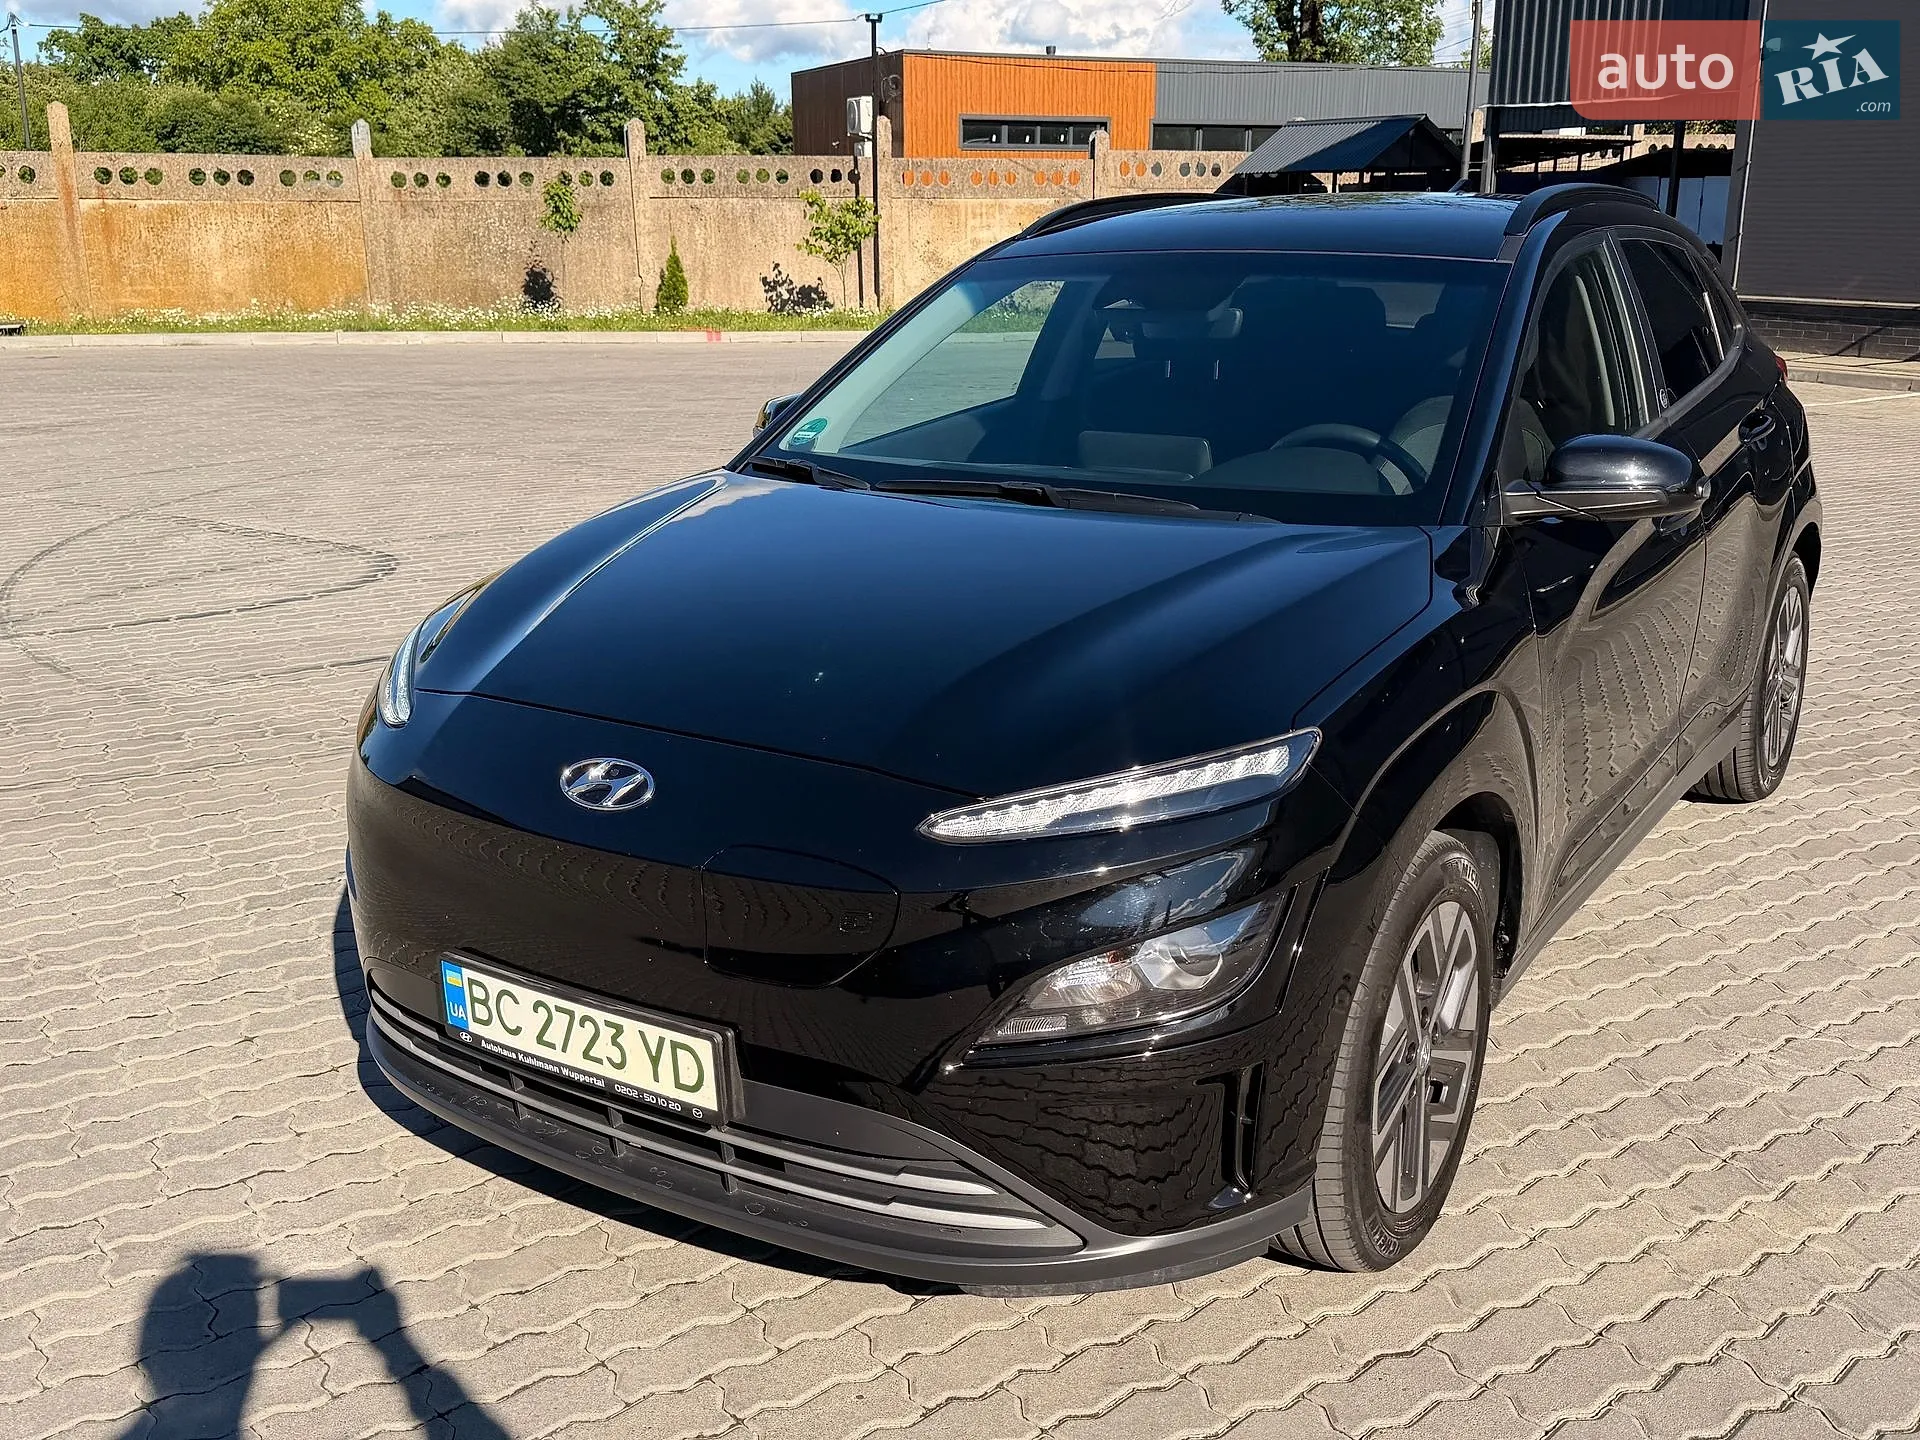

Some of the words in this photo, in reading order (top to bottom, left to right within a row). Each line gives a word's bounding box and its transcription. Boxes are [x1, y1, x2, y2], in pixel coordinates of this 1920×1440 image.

[450, 1003, 467, 1021] UA
[467, 977, 522, 1036] BC
[532, 1000, 627, 1070] 2723
[638, 1030, 705, 1093] YD
[481, 1040, 517, 1059] Autohaus
[518, 1053, 560, 1074] Kuhlmann
[561, 1065, 605, 1087] Wuppertal
